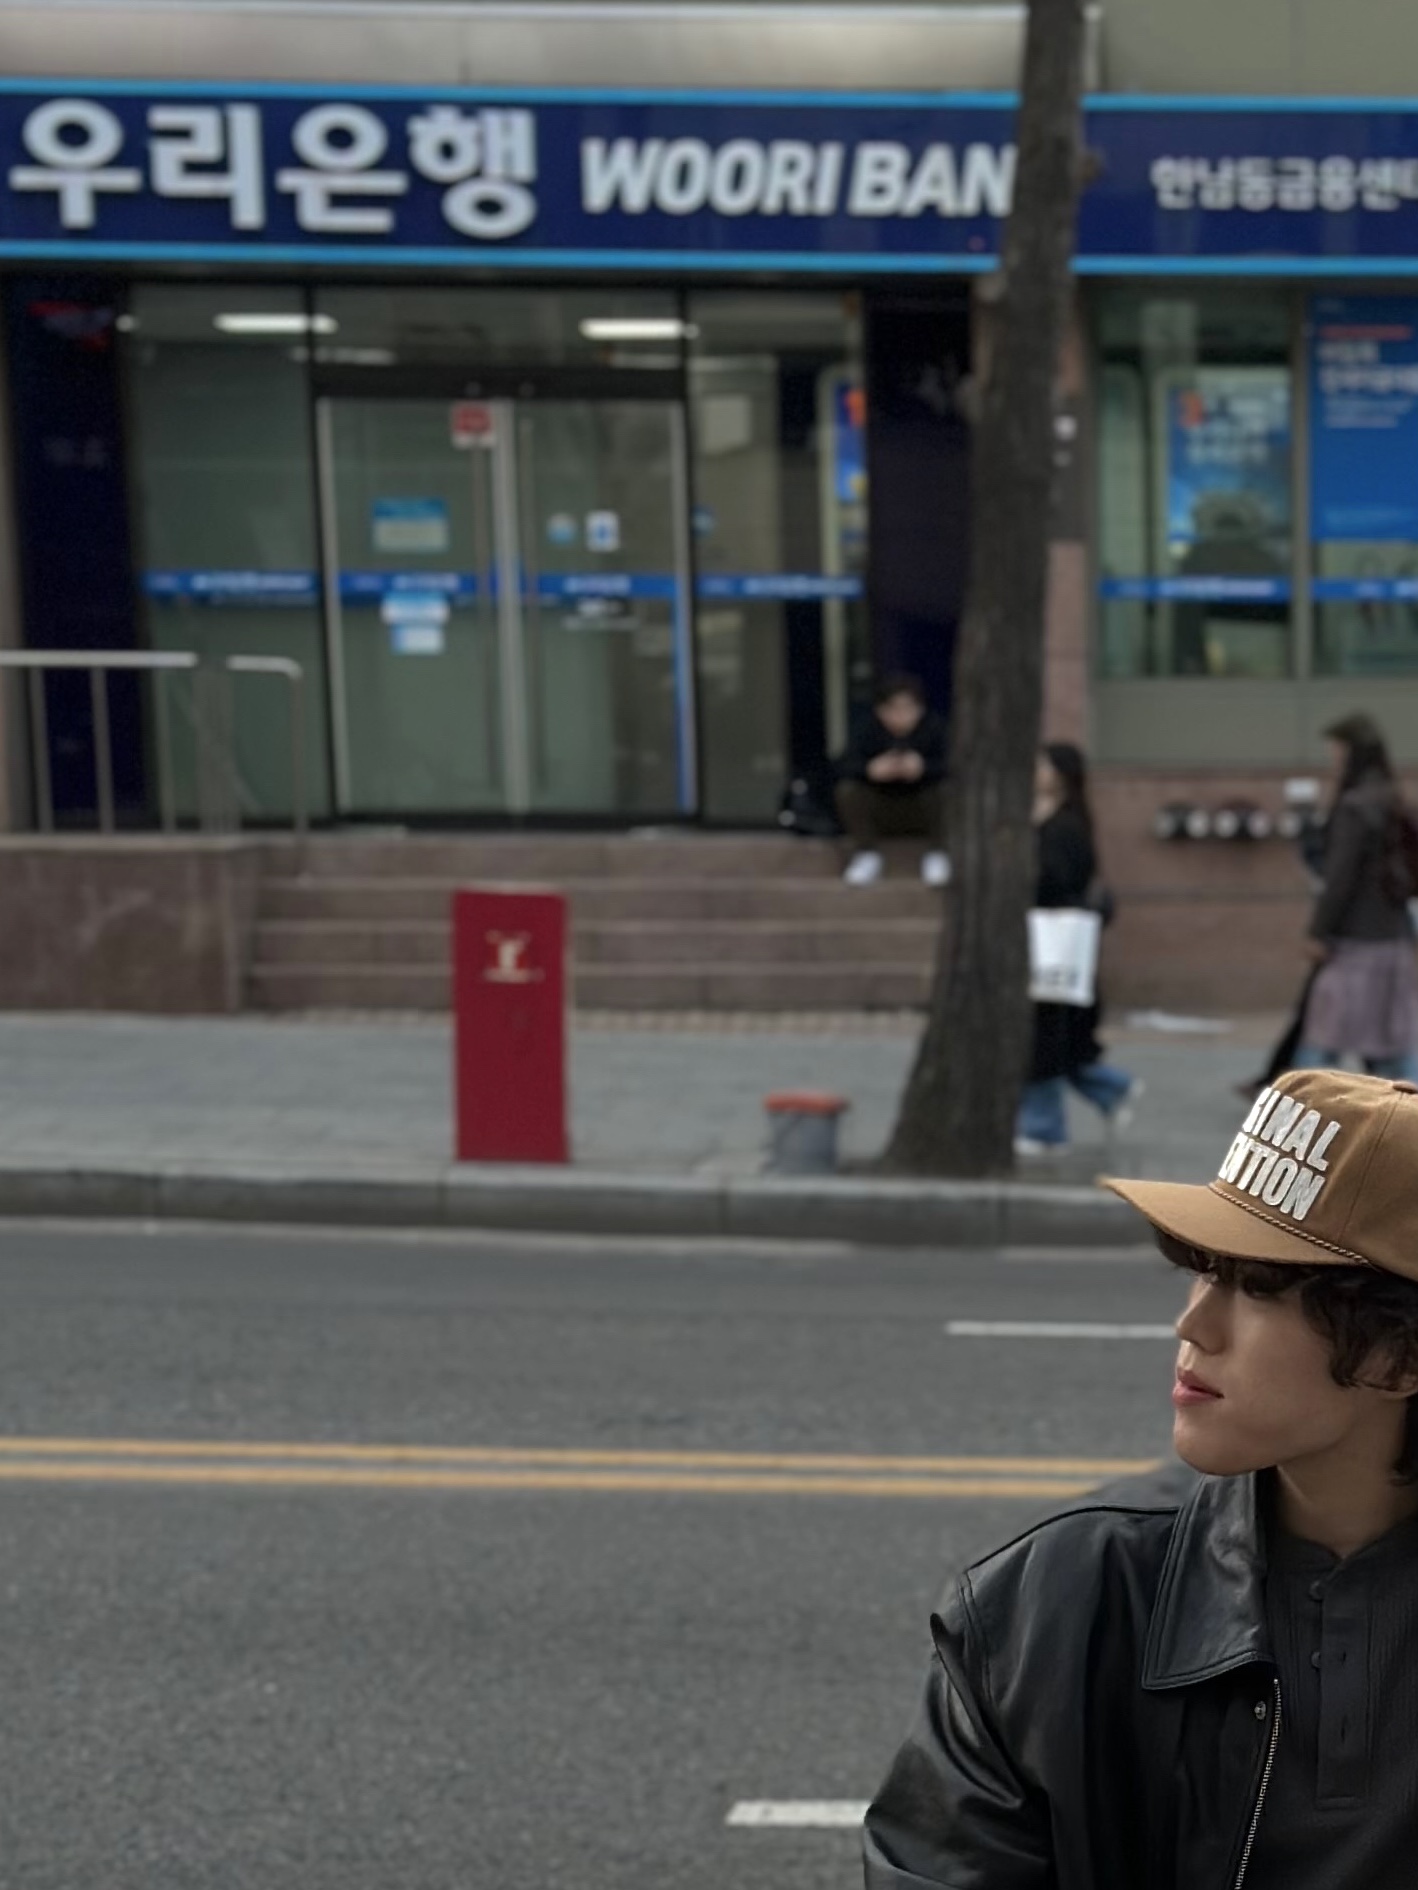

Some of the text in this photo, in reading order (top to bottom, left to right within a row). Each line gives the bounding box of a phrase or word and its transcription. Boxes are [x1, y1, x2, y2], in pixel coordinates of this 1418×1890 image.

[8, 98, 538, 240] 우리은행
[581, 138, 1019, 217] WOORI BAN
